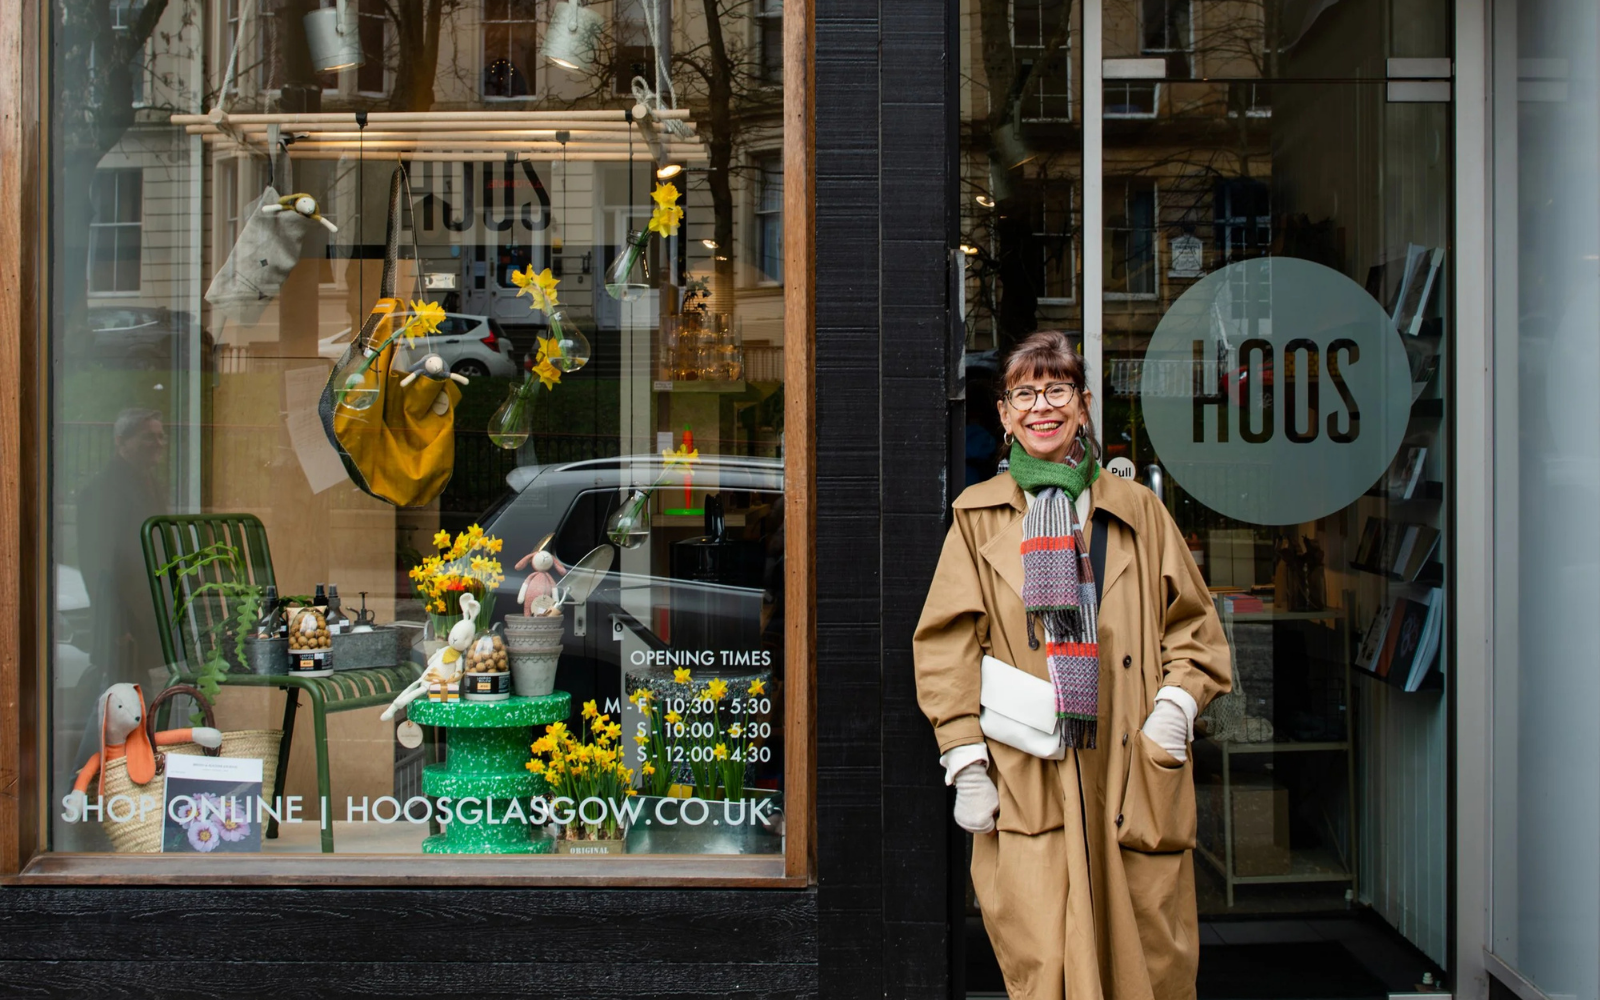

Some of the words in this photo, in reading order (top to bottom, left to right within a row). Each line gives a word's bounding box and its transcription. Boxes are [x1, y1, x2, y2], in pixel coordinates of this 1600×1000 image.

[1193, 338, 1360, 443] HOOS
[1111, 467, 1132, 477] Pull
[630, 650, 715, 666] OPENING
[720, 650, 771, 666] TIMES
[604, 697, 621, 714] M
[638, 698, 647, 714] F
[665, 698, 714, 714] 10:30
[730, 698, 771, 714] 5:30
[637, 722, 647, 738] S
[665, 722, 714, 738] 10:00
[730, 722, 771, 738] 5:30
[637, 746, 647, 762] S
[665, 746, 714, 762] 12:00
[730, 746, 771, 762] 4:30
[61, 794, 156, 823] SHOP
[168, 795, 303, 825] ONLINE
[347, 796, 771, 826] HOOSGLASGOW.CO.UK
[570, 846, 609, 854] ORIGINAL
